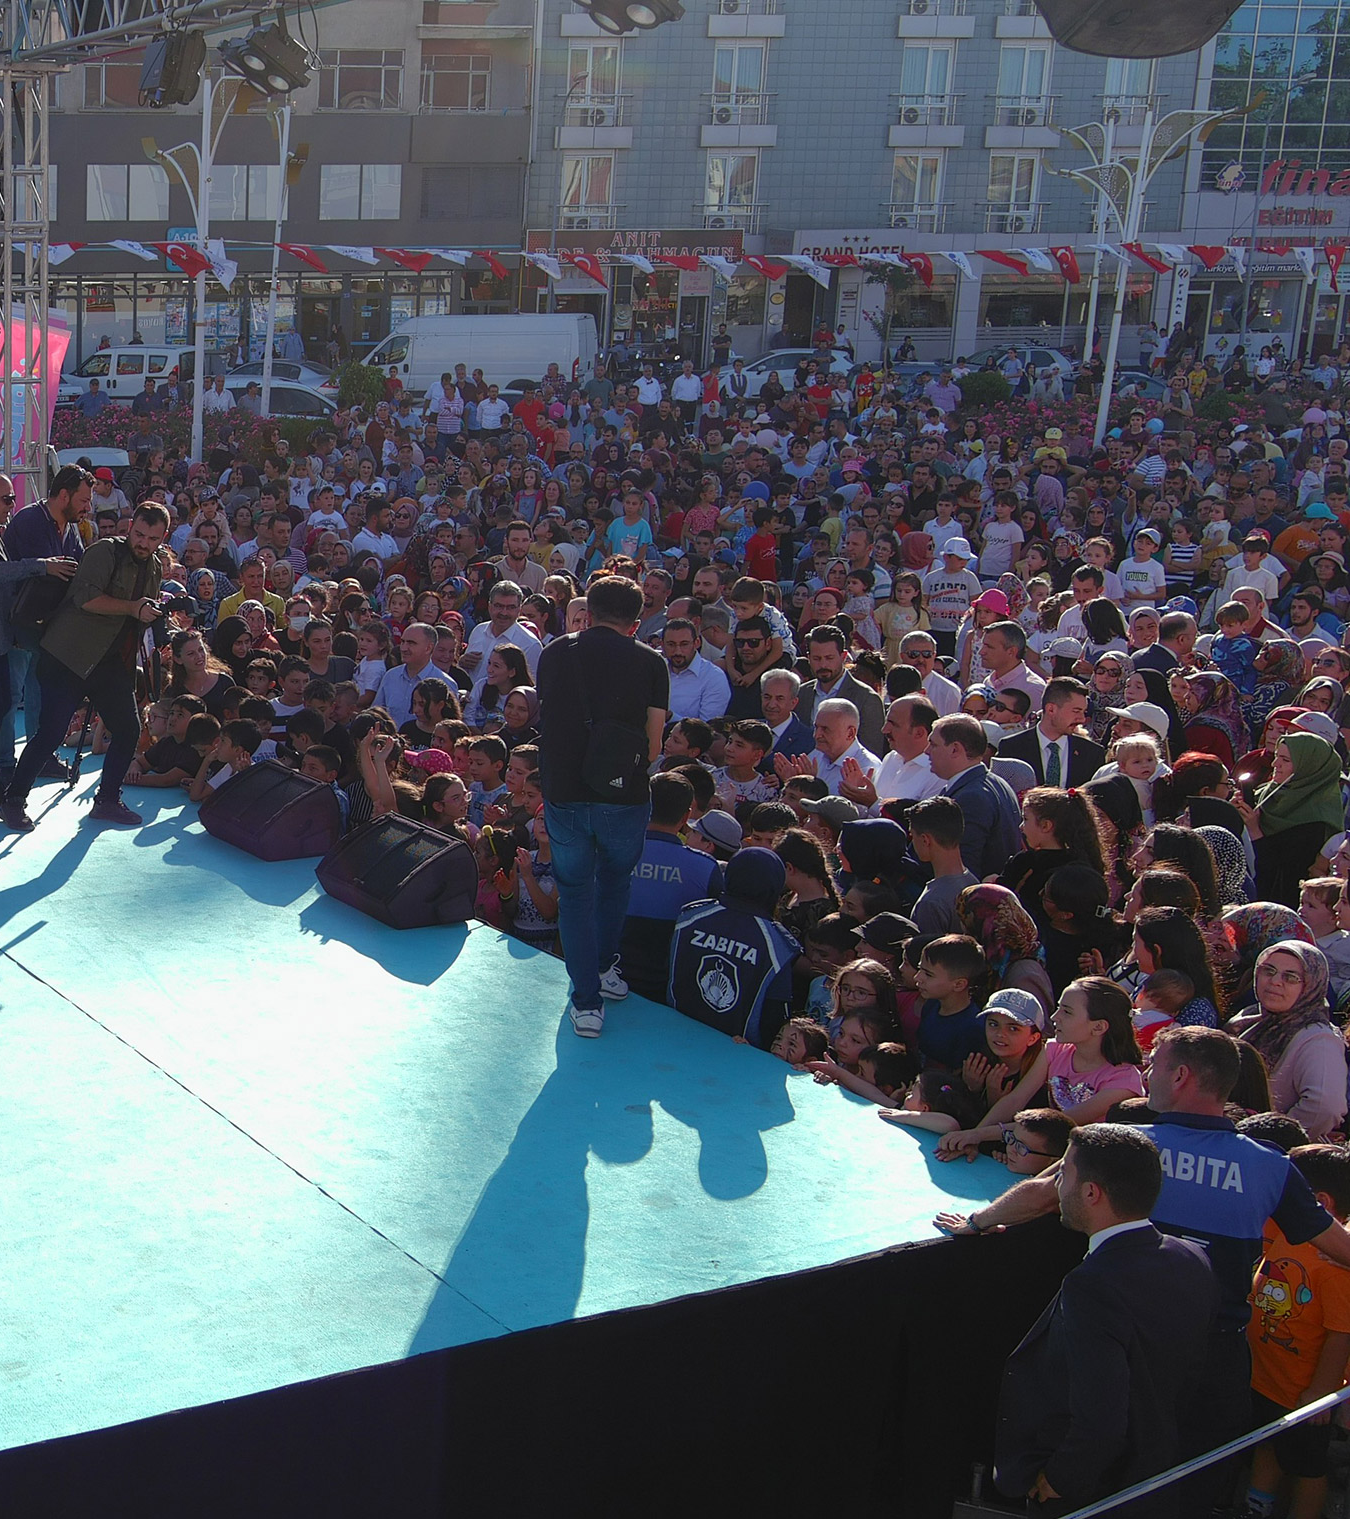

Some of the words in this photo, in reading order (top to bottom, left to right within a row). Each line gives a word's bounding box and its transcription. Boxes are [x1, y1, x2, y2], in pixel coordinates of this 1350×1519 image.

[1258, 206, 1334, 226] EĞİTİM
[611, 231, 662, 247] ANIT
[801, 246, 854, 262] GRAND
[1125, 572, 1148, 581] YOUNG
[631, 862, 683, 884] ABITA
[691, 928, 758, 966] ZABITA
[1161, 1147, 1245, 1194] ABITA
